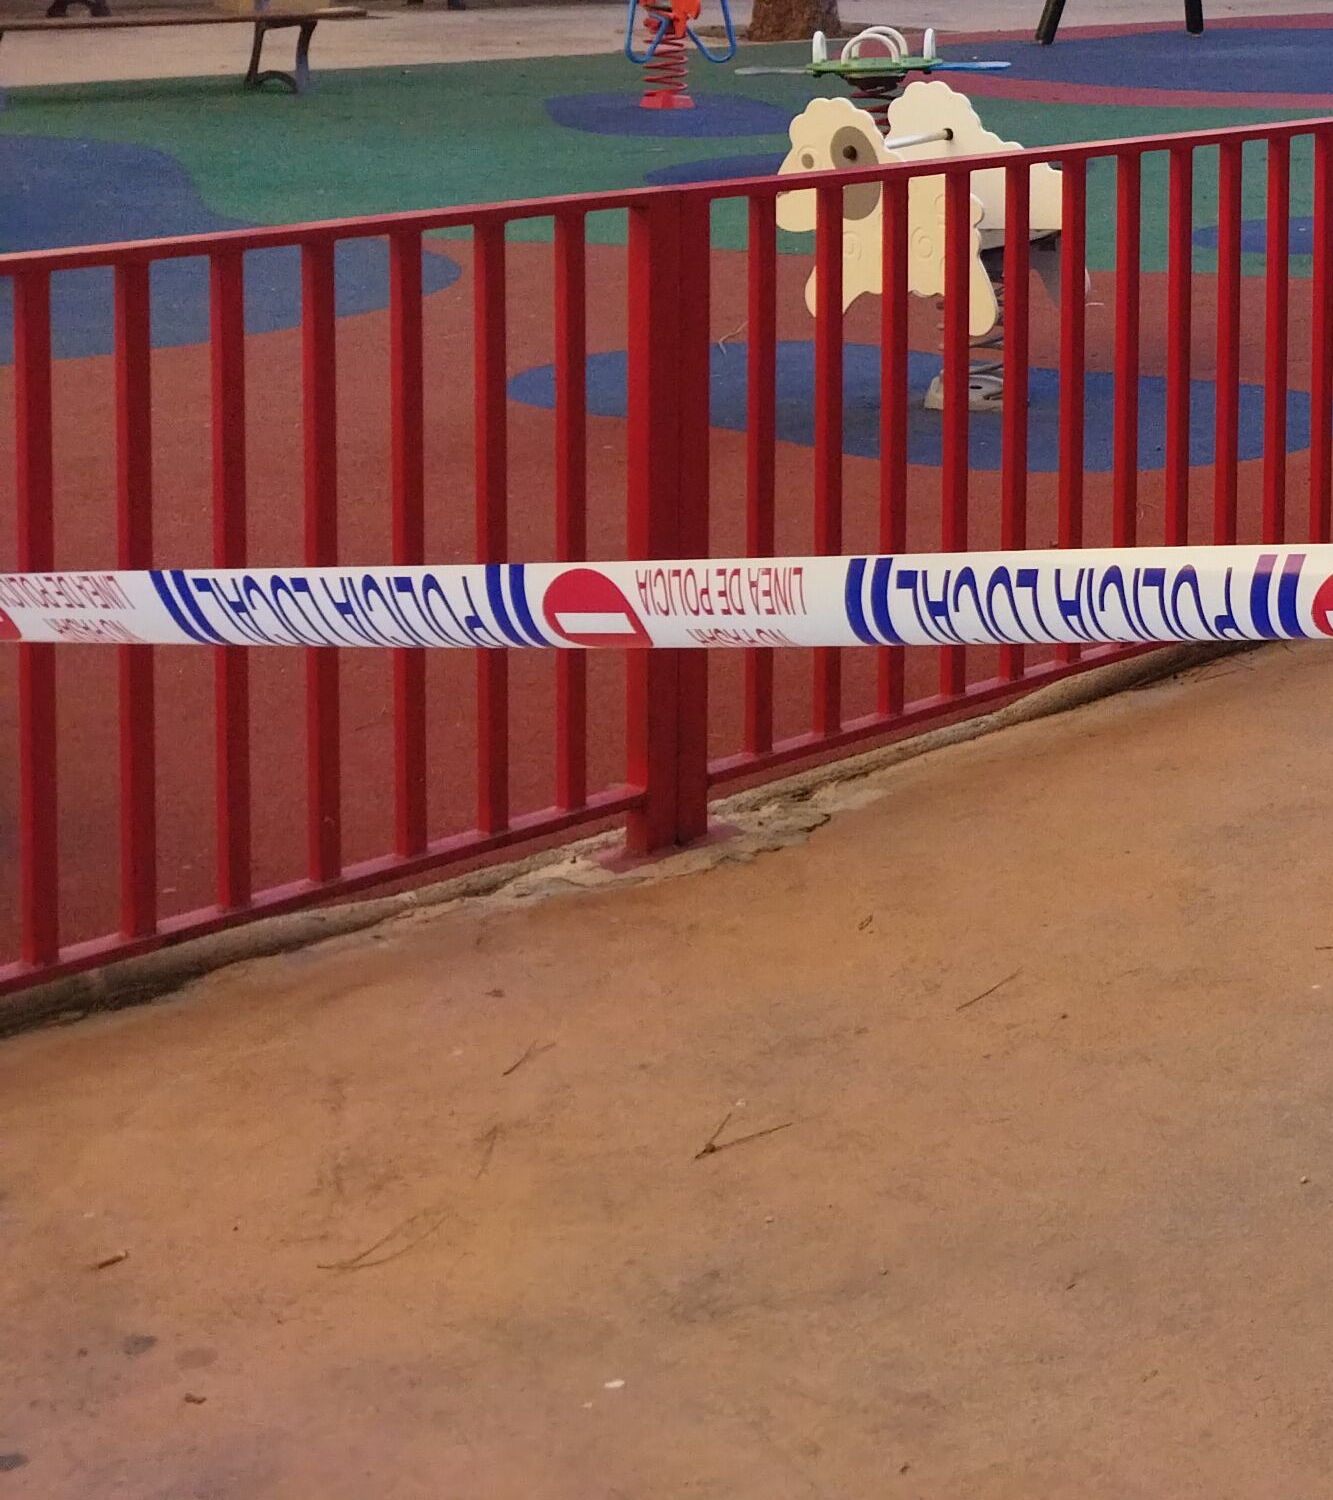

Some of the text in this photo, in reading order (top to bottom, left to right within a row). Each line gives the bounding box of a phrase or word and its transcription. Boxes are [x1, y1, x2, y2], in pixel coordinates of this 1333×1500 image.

[43, 575, 87, 610] DE
[68, 575, 136, 611] LINEA
[192, 574, 504, 648] POLICIA LOCAL
[635, 566, 807, 617] LINEA DE POLICIA
[896, 564, 1247, 644] POLICIA LOCAL
